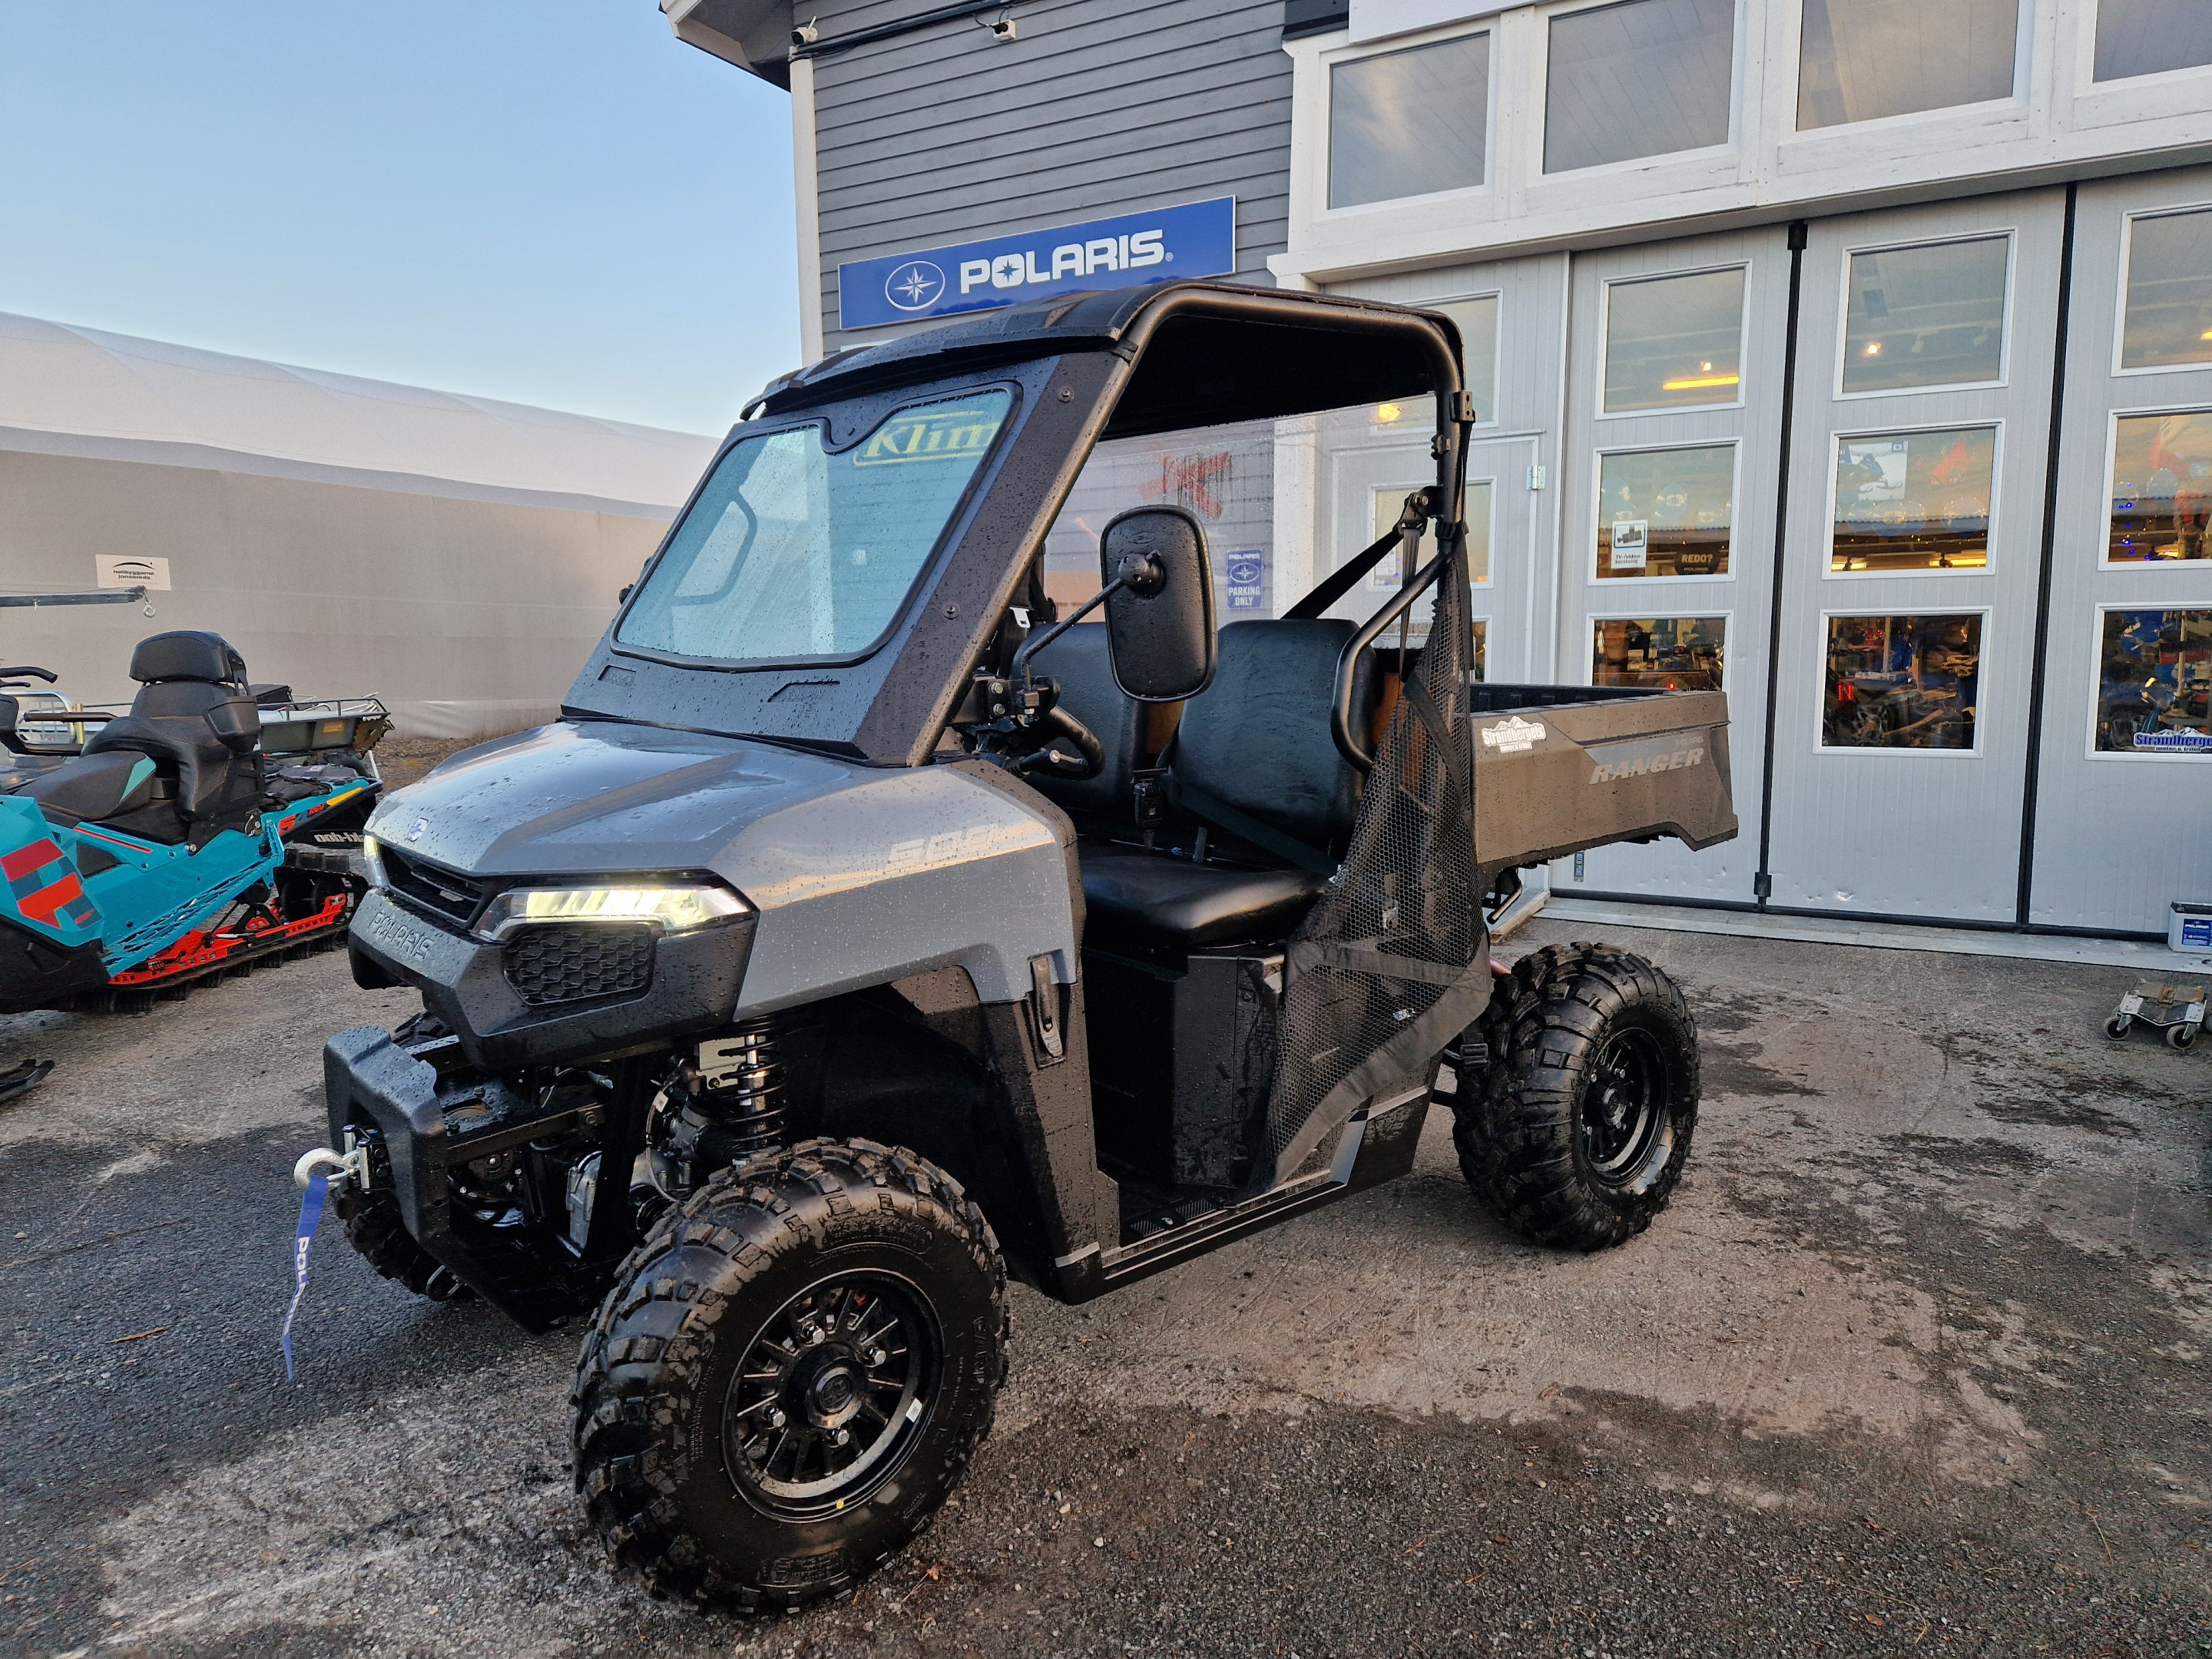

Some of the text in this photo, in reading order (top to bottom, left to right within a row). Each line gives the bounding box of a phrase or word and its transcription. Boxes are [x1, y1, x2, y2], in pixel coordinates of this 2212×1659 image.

[960, 229, 1164, 294] POLARIS
[1681, 554, 1714, 564] REDO?
[1228, 585, 1260, 596] PARKING
[1234, 596, 1253, 606] ONLY
[1482, 725, 1545, 746] Strandbergets
[1588, 747, 1704, 785] RANGER
